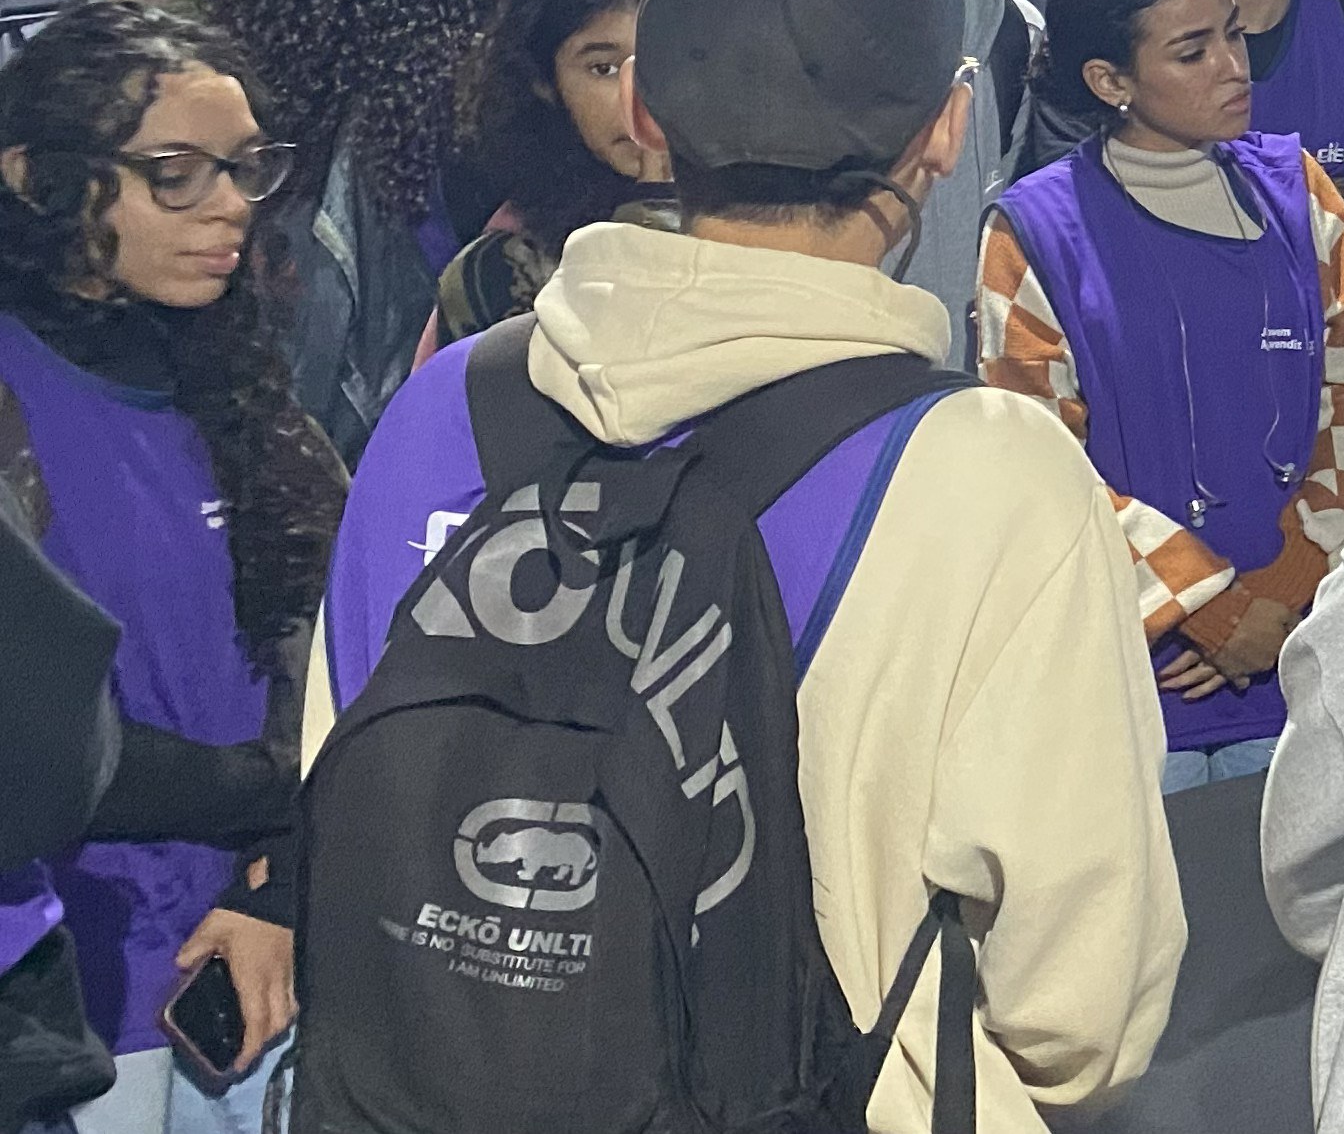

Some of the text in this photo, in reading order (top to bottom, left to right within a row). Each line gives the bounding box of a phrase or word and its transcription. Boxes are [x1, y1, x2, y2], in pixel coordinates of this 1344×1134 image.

[429, 933, 456, 952] NO
[461, 942, 557, 974] SUBSTITUTE
[557, 960, 587, 974] FOR
[482, 968, 565, 992] UNLIMITED
